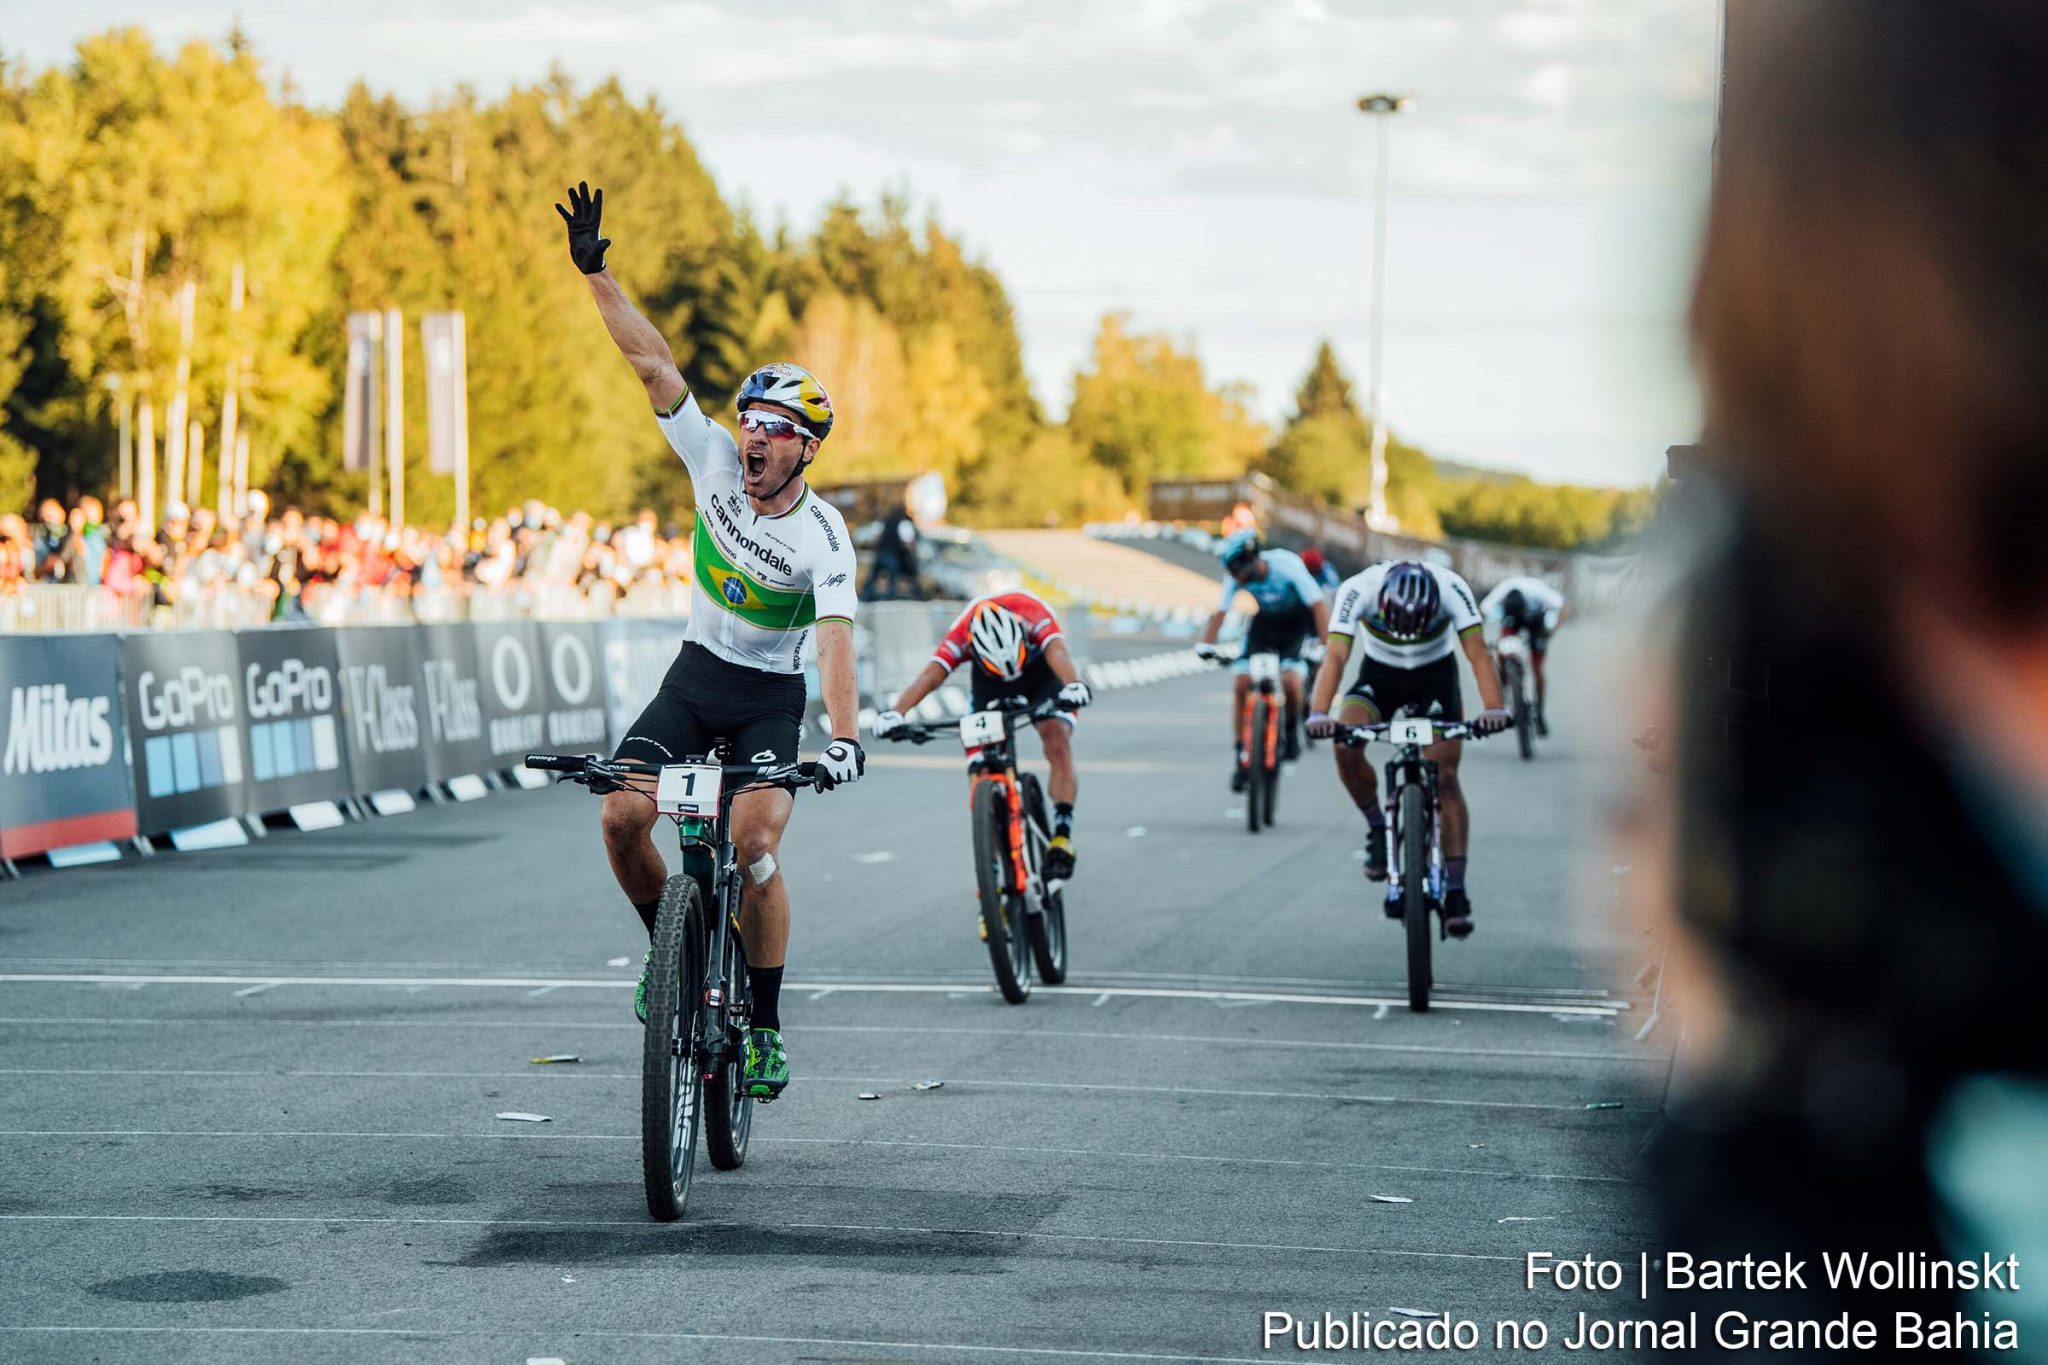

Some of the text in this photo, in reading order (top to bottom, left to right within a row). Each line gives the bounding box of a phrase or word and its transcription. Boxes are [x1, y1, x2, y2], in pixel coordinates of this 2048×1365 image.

[711, 493, 793, 577] cannondale
[810, 505, 840, 553] cannondale
[138, 665, 237, 731] GoPro
[246, 658, 332, 719] GoPro
[4, 683, 113, 776] Mitas
[975, 716, 986, 729] 4
[1405, 726, 1417, 739] 6
[682, 772, 696, 797] 1
